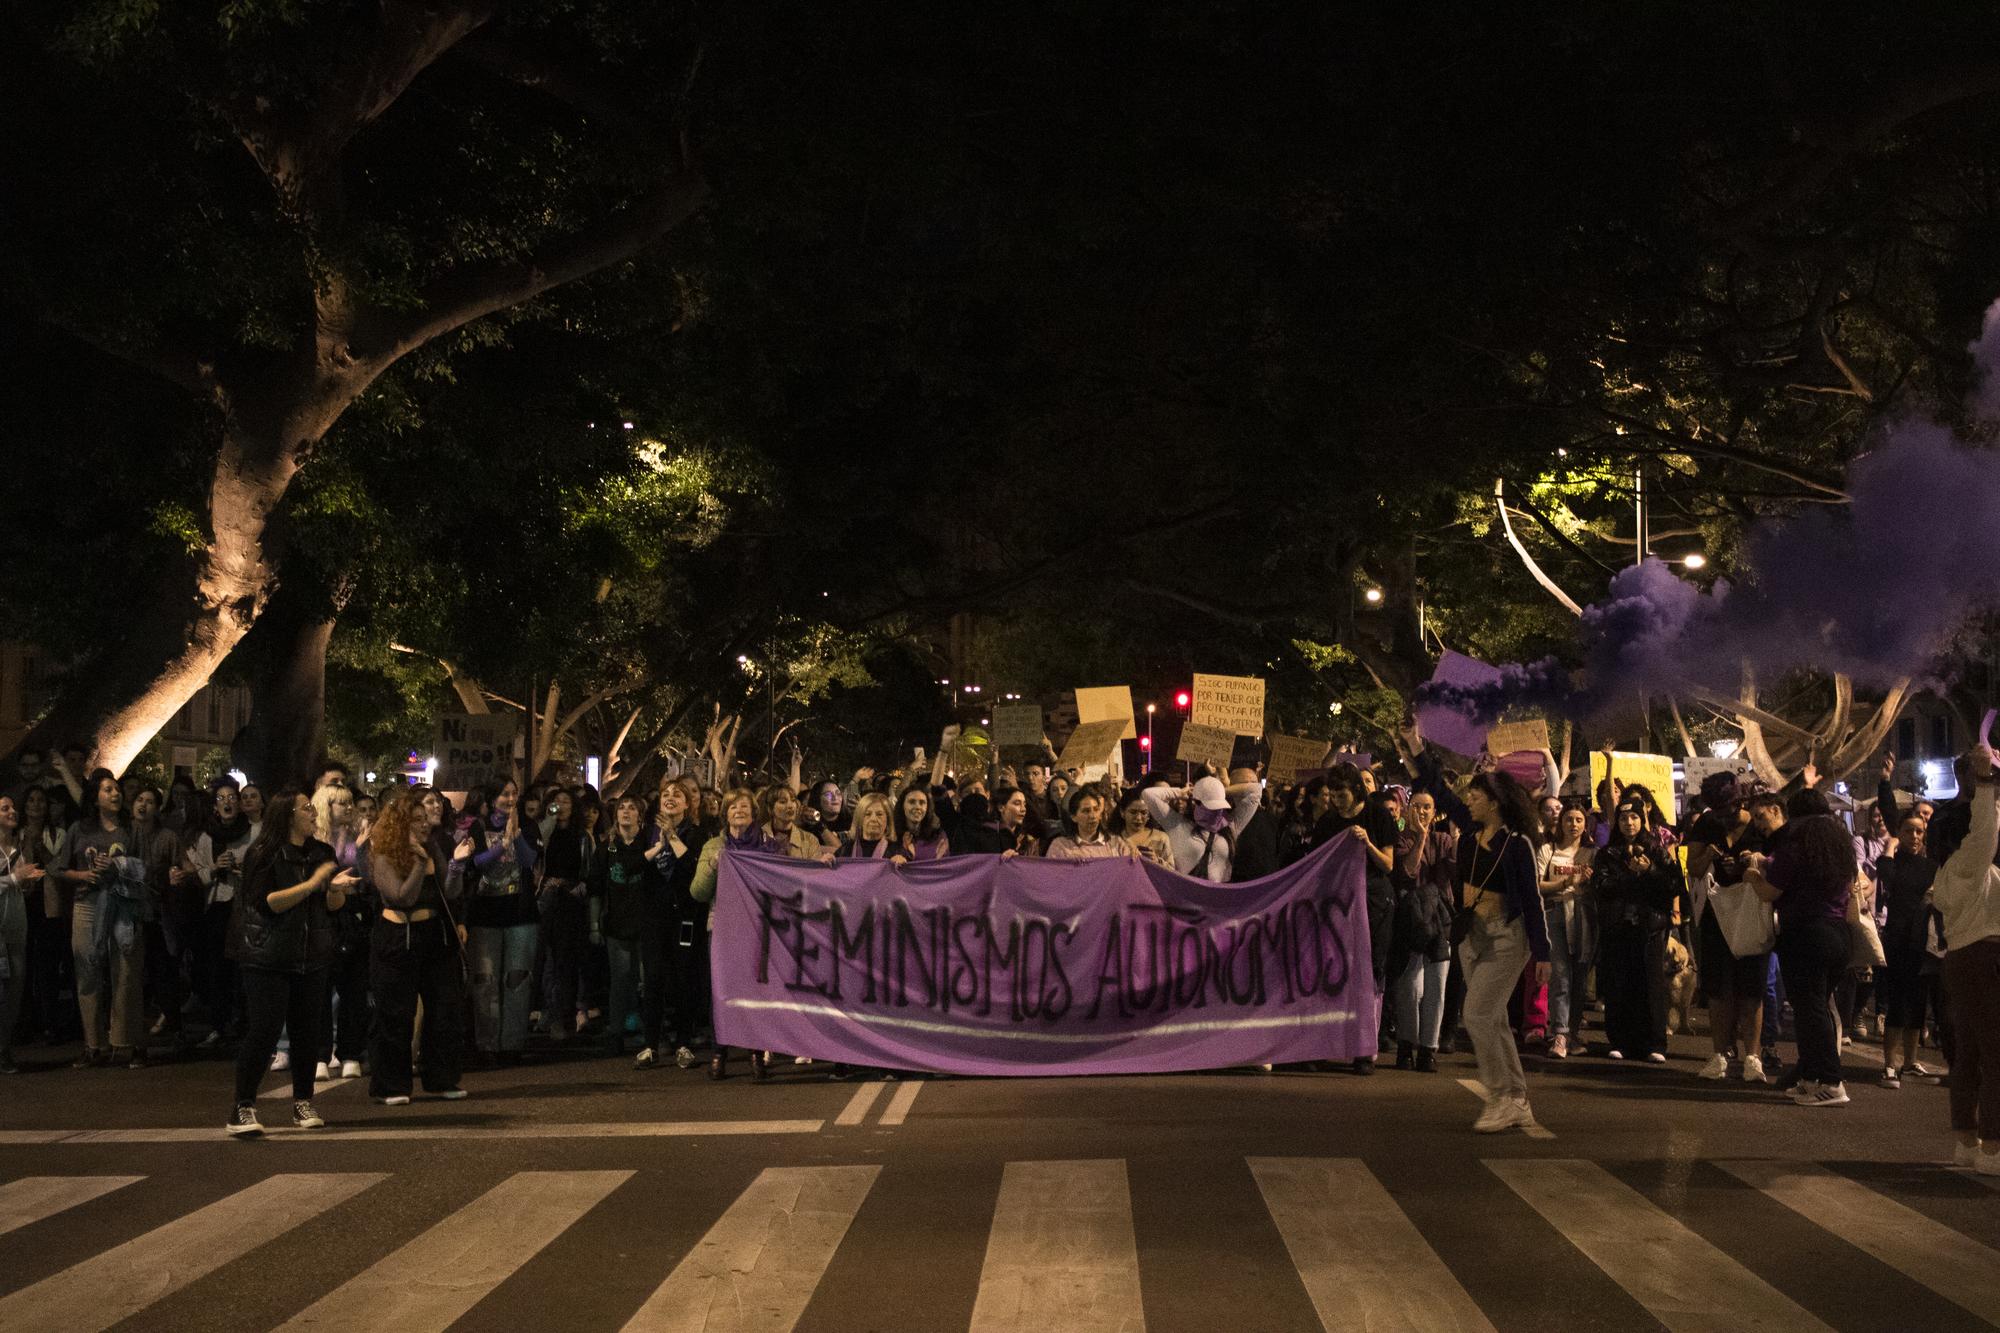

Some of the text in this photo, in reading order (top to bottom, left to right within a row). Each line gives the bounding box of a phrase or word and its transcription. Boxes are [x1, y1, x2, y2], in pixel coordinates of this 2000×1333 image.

[1197, 689, 1263, 706] POR TENER QUE
[1196, 701, 1262, 718] PROTESTAR POR
[1207, 714, 1262, 730] ESTA MIERDA
[449, 748, 494, 765] PASO
[757, 890, 1078, 1022] FEMINISMOS
